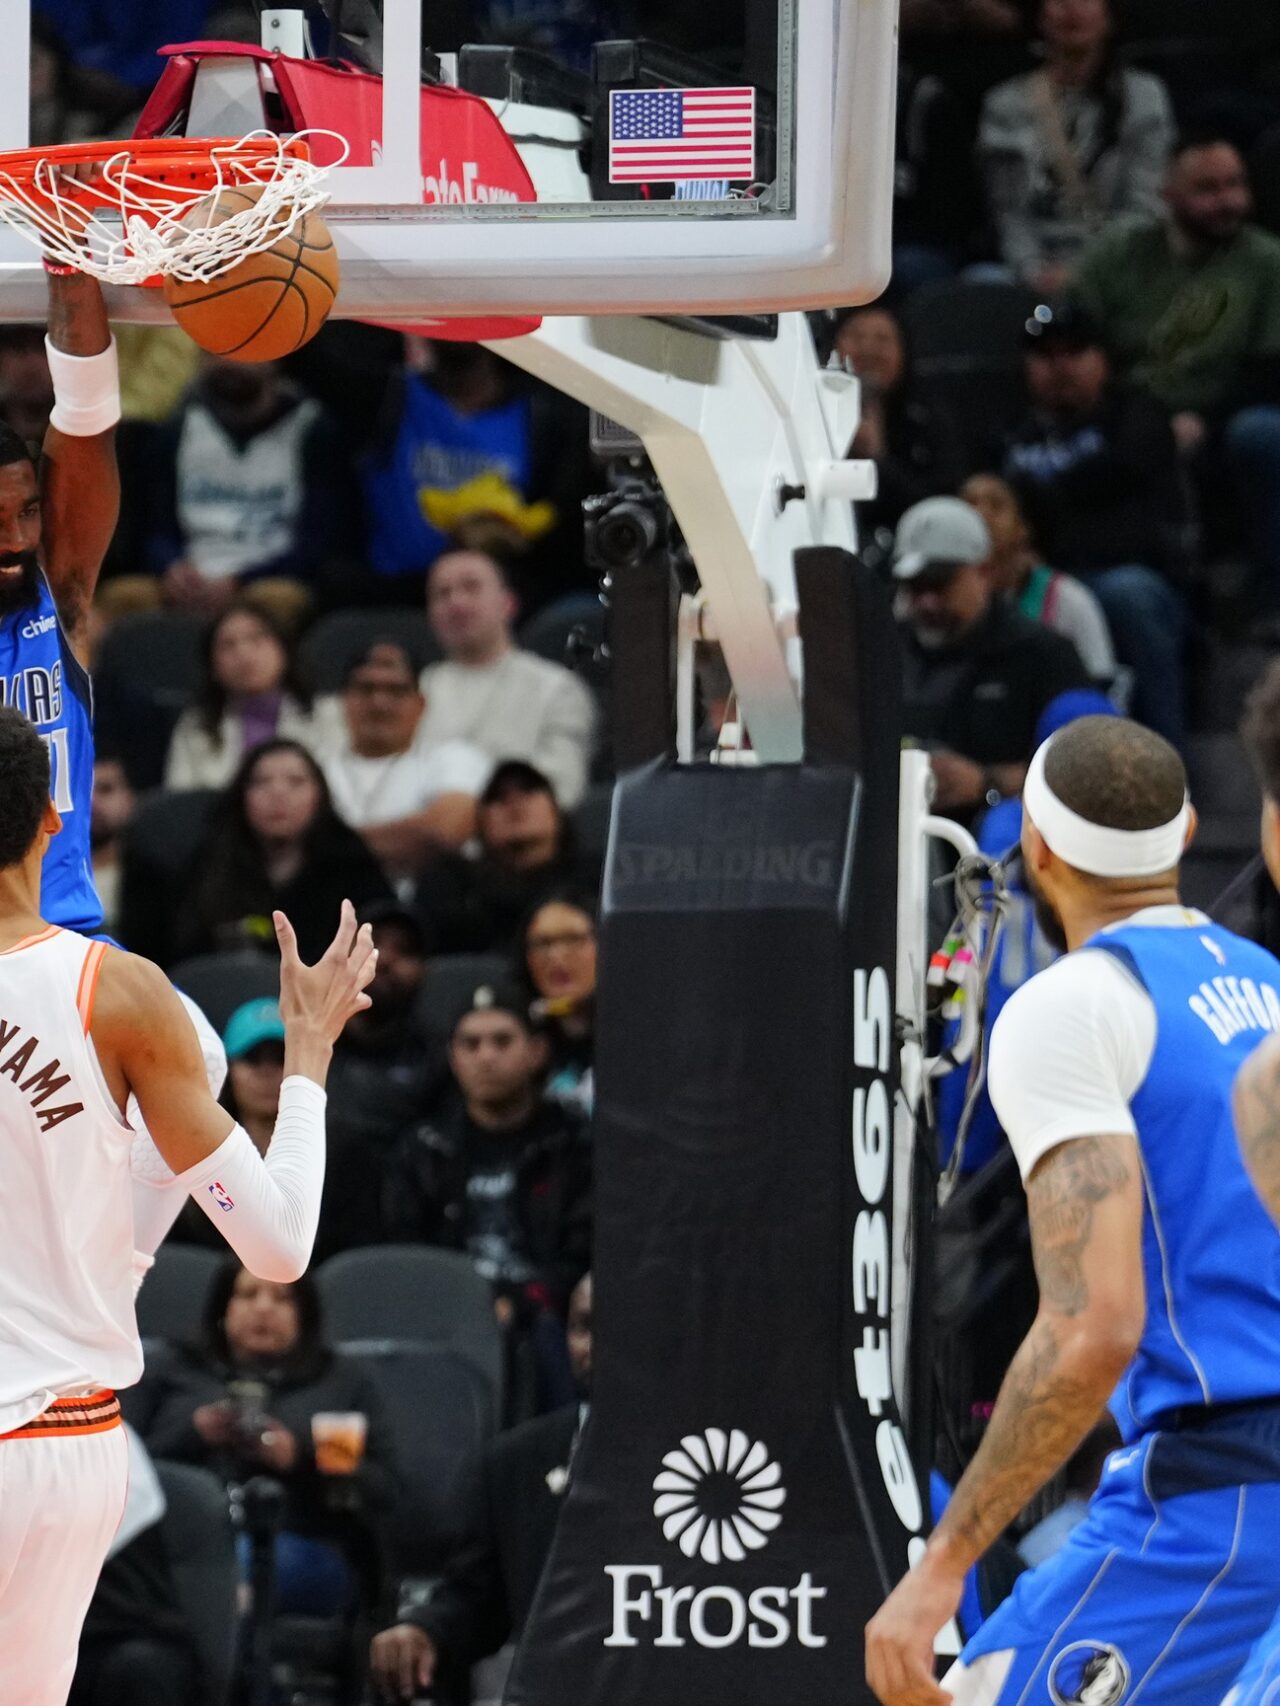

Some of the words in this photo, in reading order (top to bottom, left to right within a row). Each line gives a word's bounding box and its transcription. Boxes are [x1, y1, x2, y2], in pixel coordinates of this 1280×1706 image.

[22, 614, 57, 639] chime
[616, 840, 836, 888] SPALDING
[603, 1564, 828, 1649] Frost
